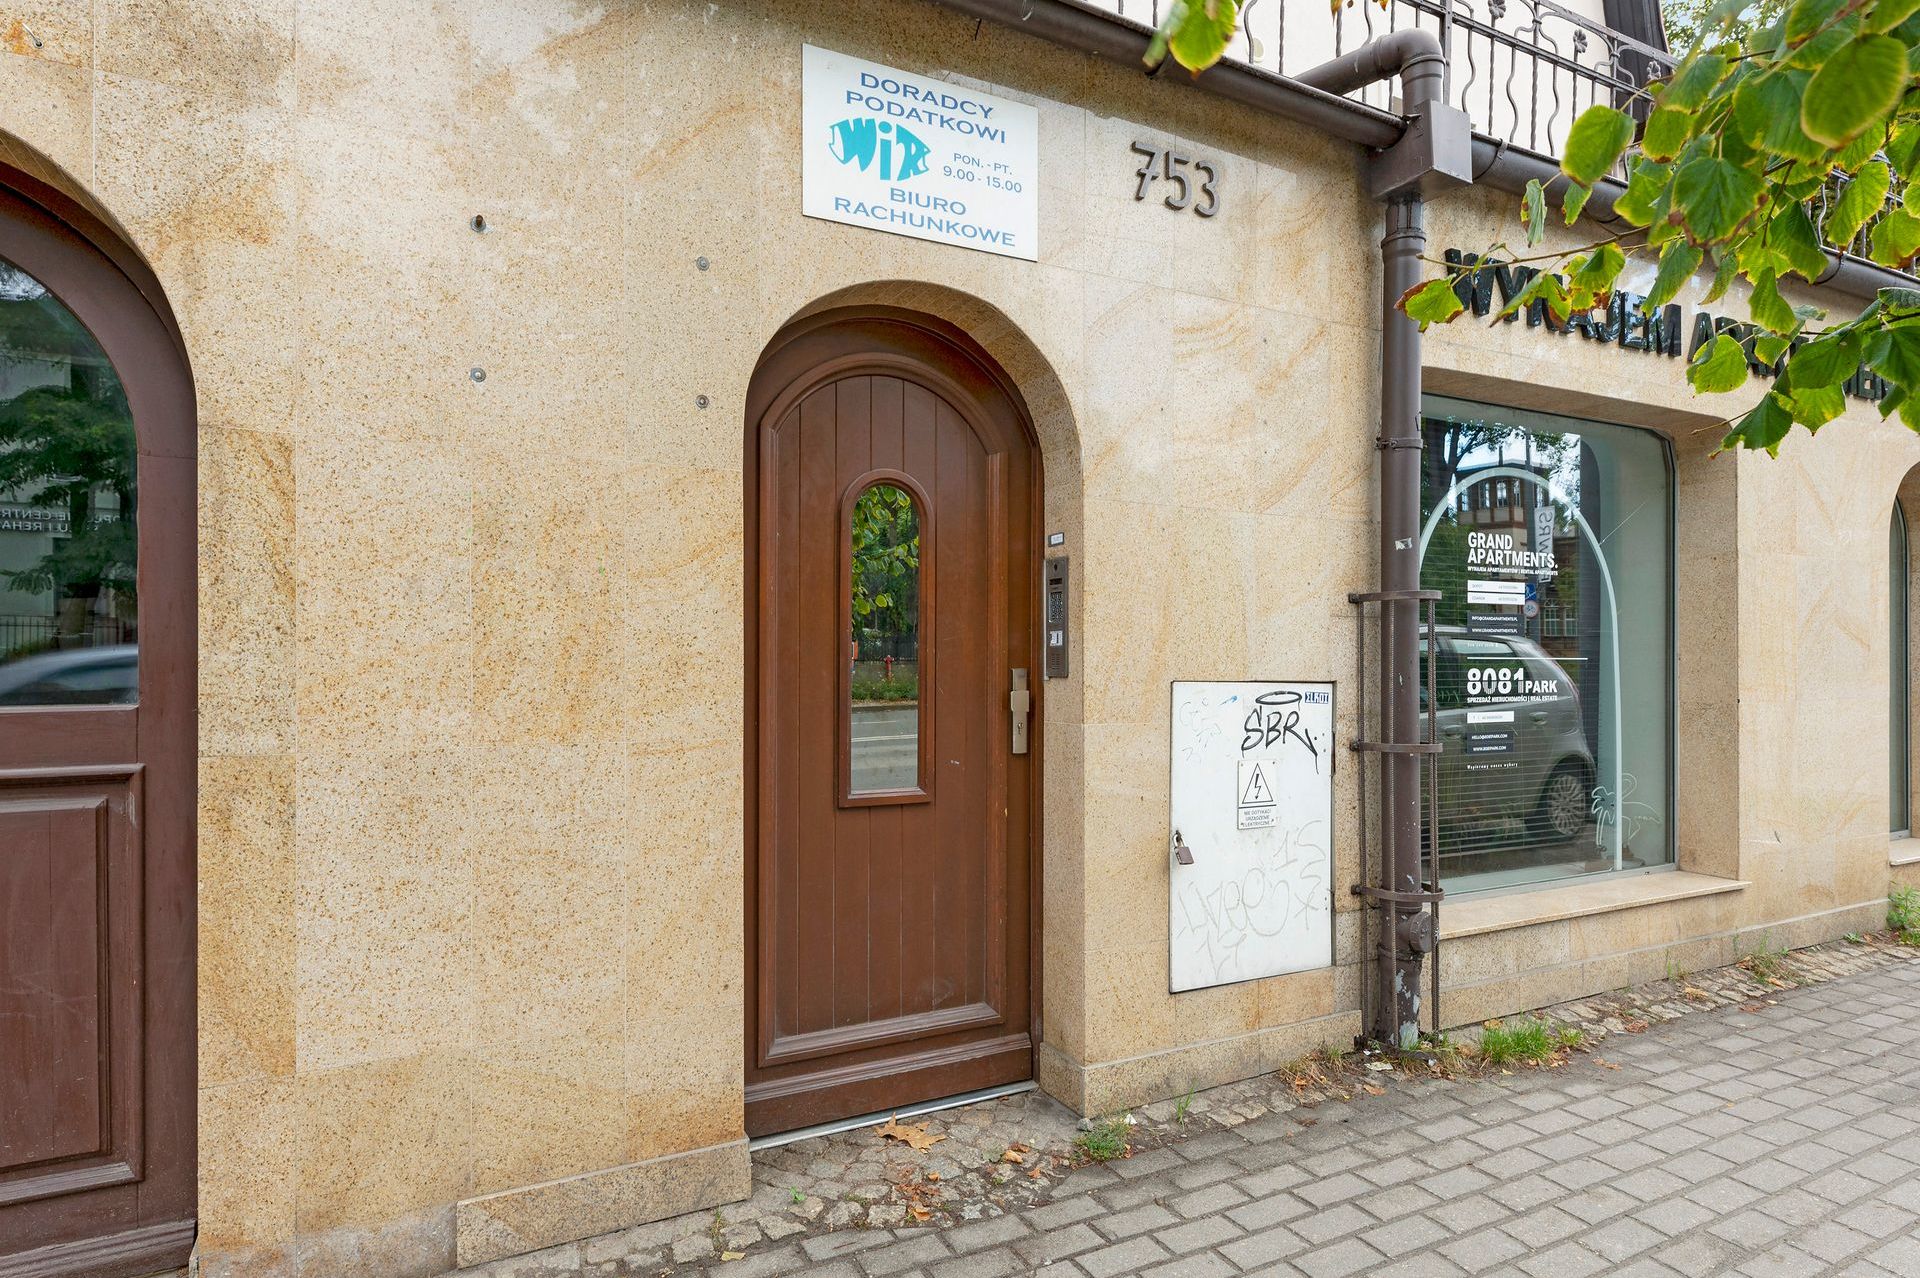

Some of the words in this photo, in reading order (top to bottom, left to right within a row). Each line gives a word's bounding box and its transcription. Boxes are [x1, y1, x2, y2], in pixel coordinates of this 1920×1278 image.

[860, 72, 994, 120] DORADCY
[846, 90, 1006, 144] PODATKOWI
[953, 153, 984, 169] PON.
[993, 162, 1013, 175] PT.
[943, 165, 975, 182] 9.00
[986, 175, 1022, 193] 15.00
[1131, 141, 1220, 218] 753
[889, 187, 967, 215] BIURO
[834, 196, 1016, 247] RACHUNKOWE
[1467, 532, 1513, 550] GRAND
[1467, 548, 1559, 569] APARTMENTS.
[1467, 667, 1524, 695] 8081
[1525, 680, 1558, 693] PARK
